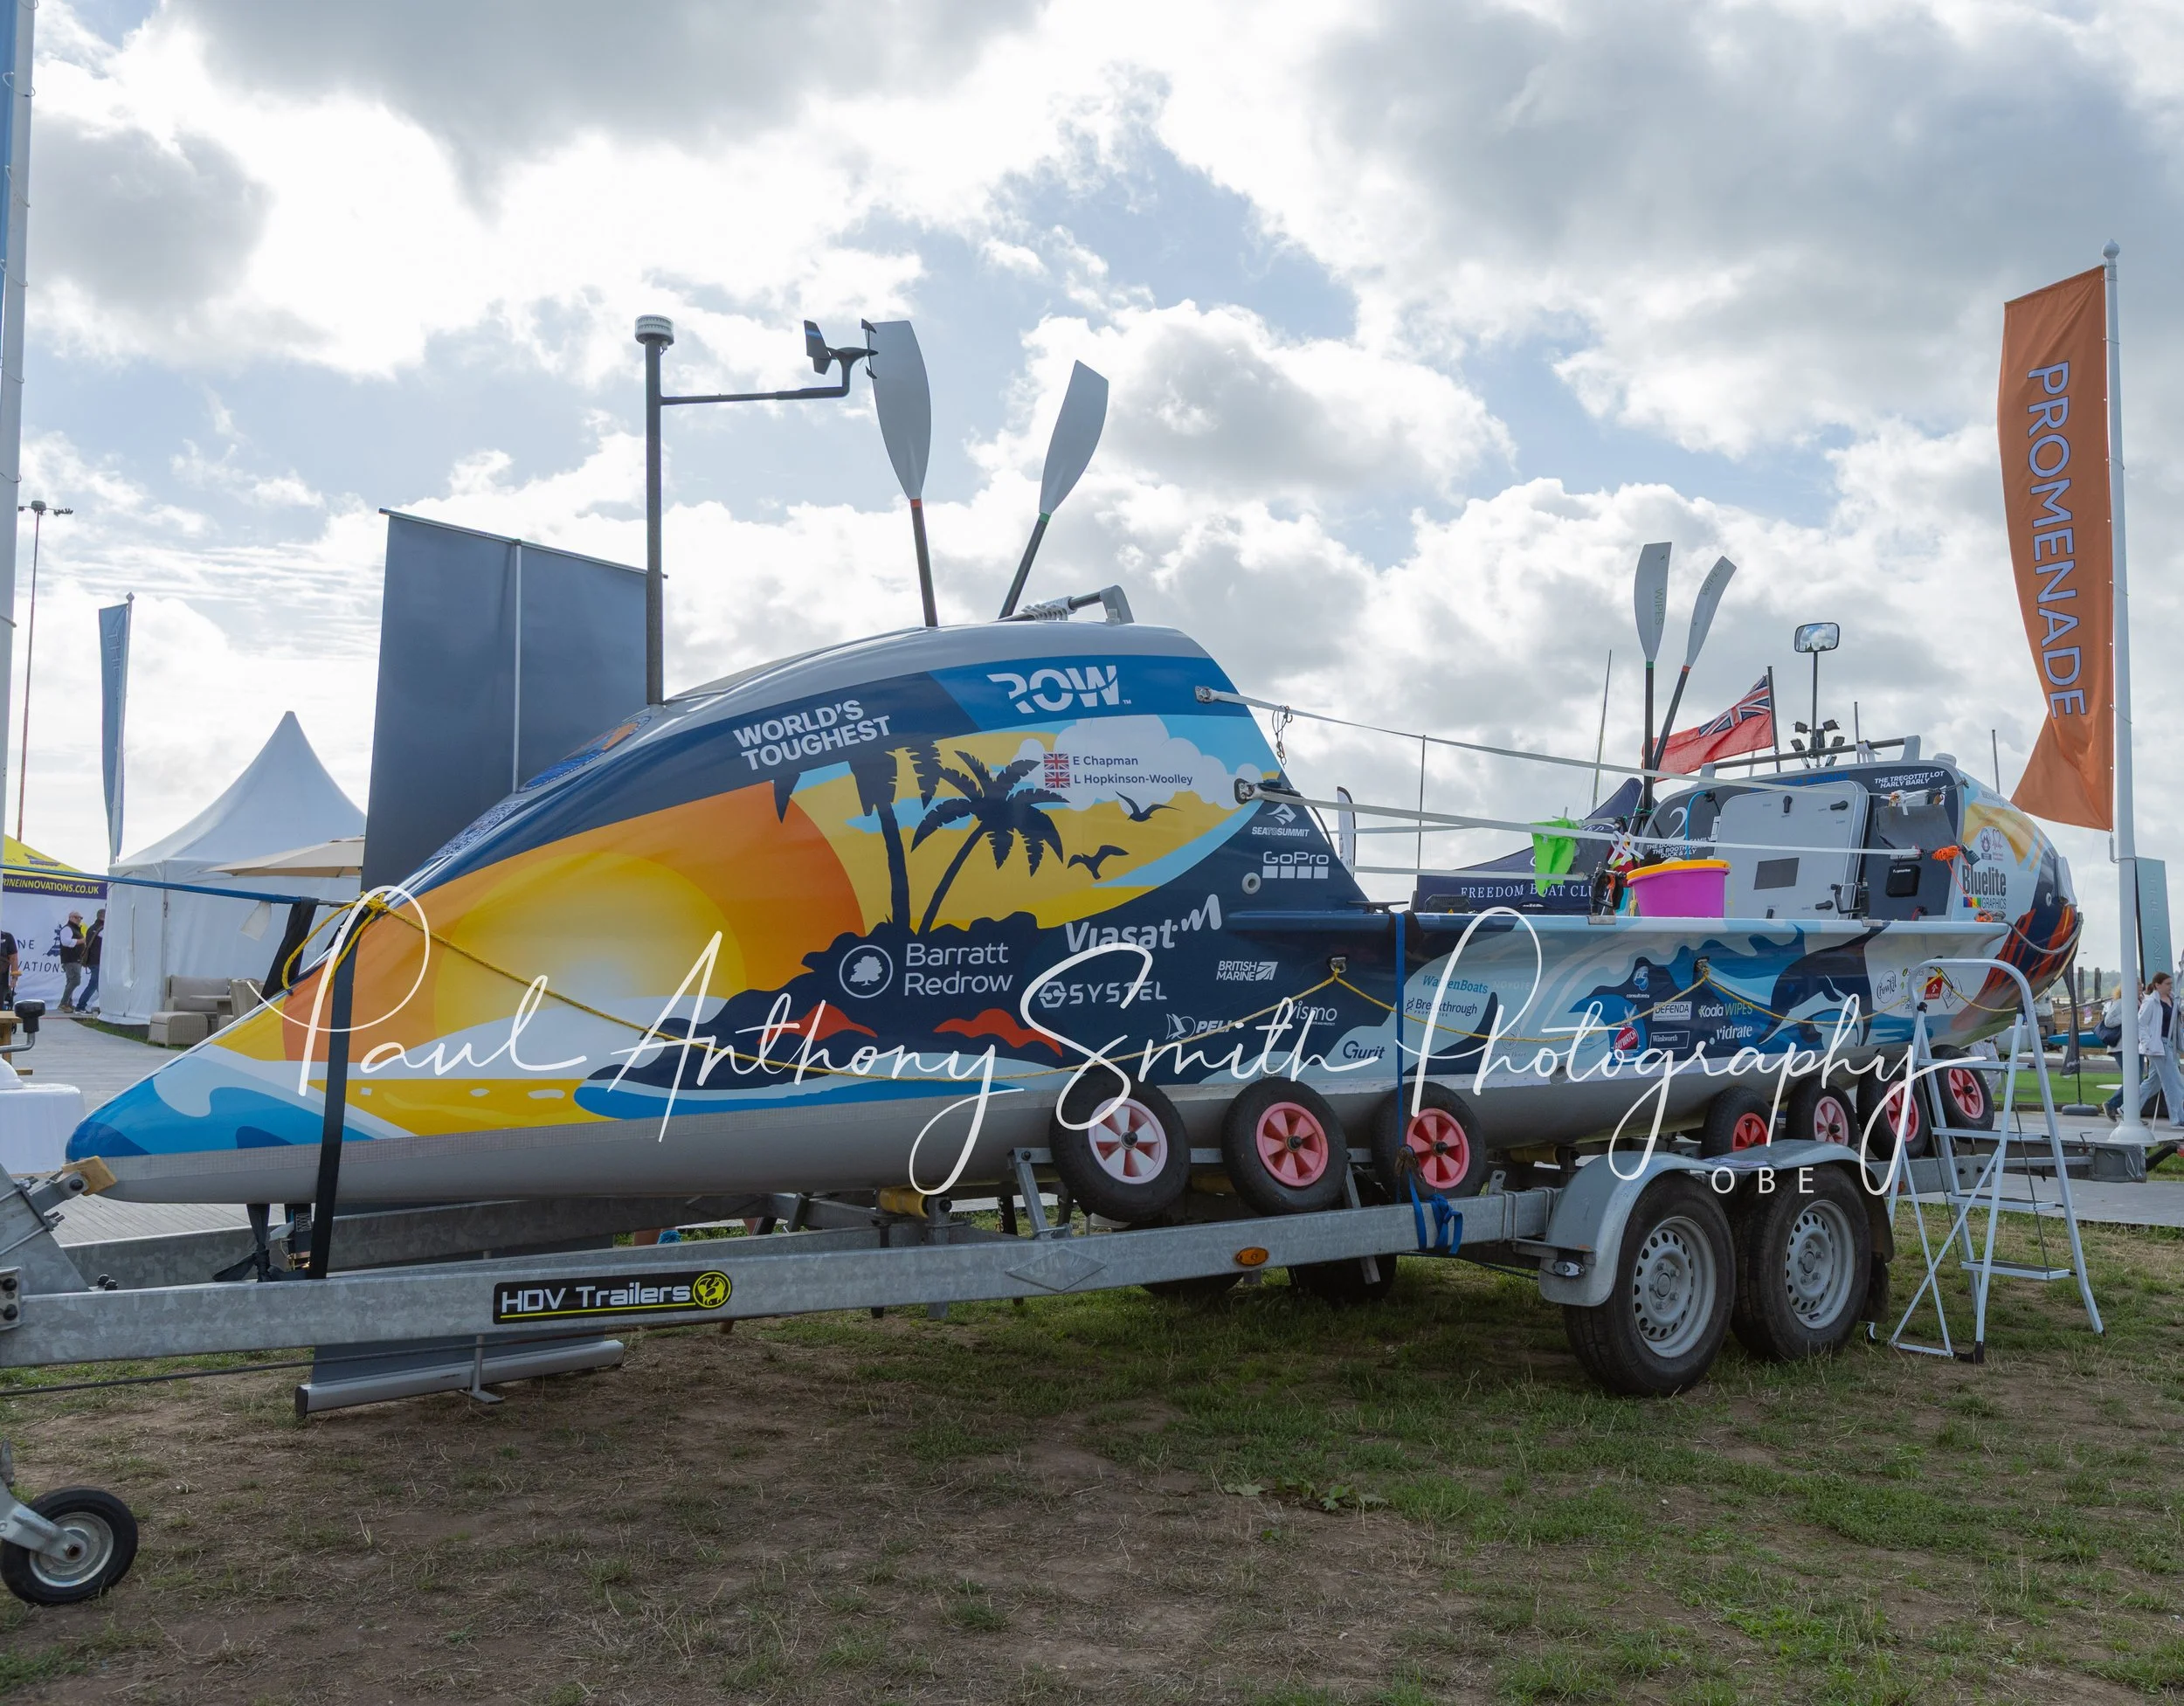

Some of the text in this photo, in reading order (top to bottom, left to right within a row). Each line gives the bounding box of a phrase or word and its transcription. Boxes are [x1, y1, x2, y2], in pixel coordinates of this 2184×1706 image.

[2027, 361, 2086, 719] PROMENADE
[1702, 563, 1724, 596] WIPES
[1655, 588, 1664, 625] WIPES
[986, 665, 1120, 714] ROW
[733, 700, 864, 748] WORLD'S
[741, 715, 890, 770] TOUGHEST
[1073, 756, 1138, 768] E Chapman
[1074, 774, 1193, 785] L Hopkinson-Woolley
[1262, 851, 1329, 865] GoPro
[1461, 884, 1524, 898] FREEDOM
[1962, 865, 2007, 896] Bluelite
[1981, 897, 2007, 909] GRAPHICS
[1065, 919, 1176, 953] Viasat
[905, 942, 1009, 966] Barratt
[1216, 970, 1255, 981] MARINE
[1218, 961, 1257, 972] BRITISH
[904, 970, 1013, 996] Redrow
[1069, 981, 1167, 1005] SYSTEL
[1423, 975, 1489, 994] WaenBoats
[1655, 1003, 1690, 1014] DEFENDA
[1700, 1002, 1753, 1019] Koala WIPES
[1652, 1033, 1678, 1042] Winkworth
[1343, 1039, 1386, 1059] Gurit
[501, 1281, 692, 1313] HDV Trailers
